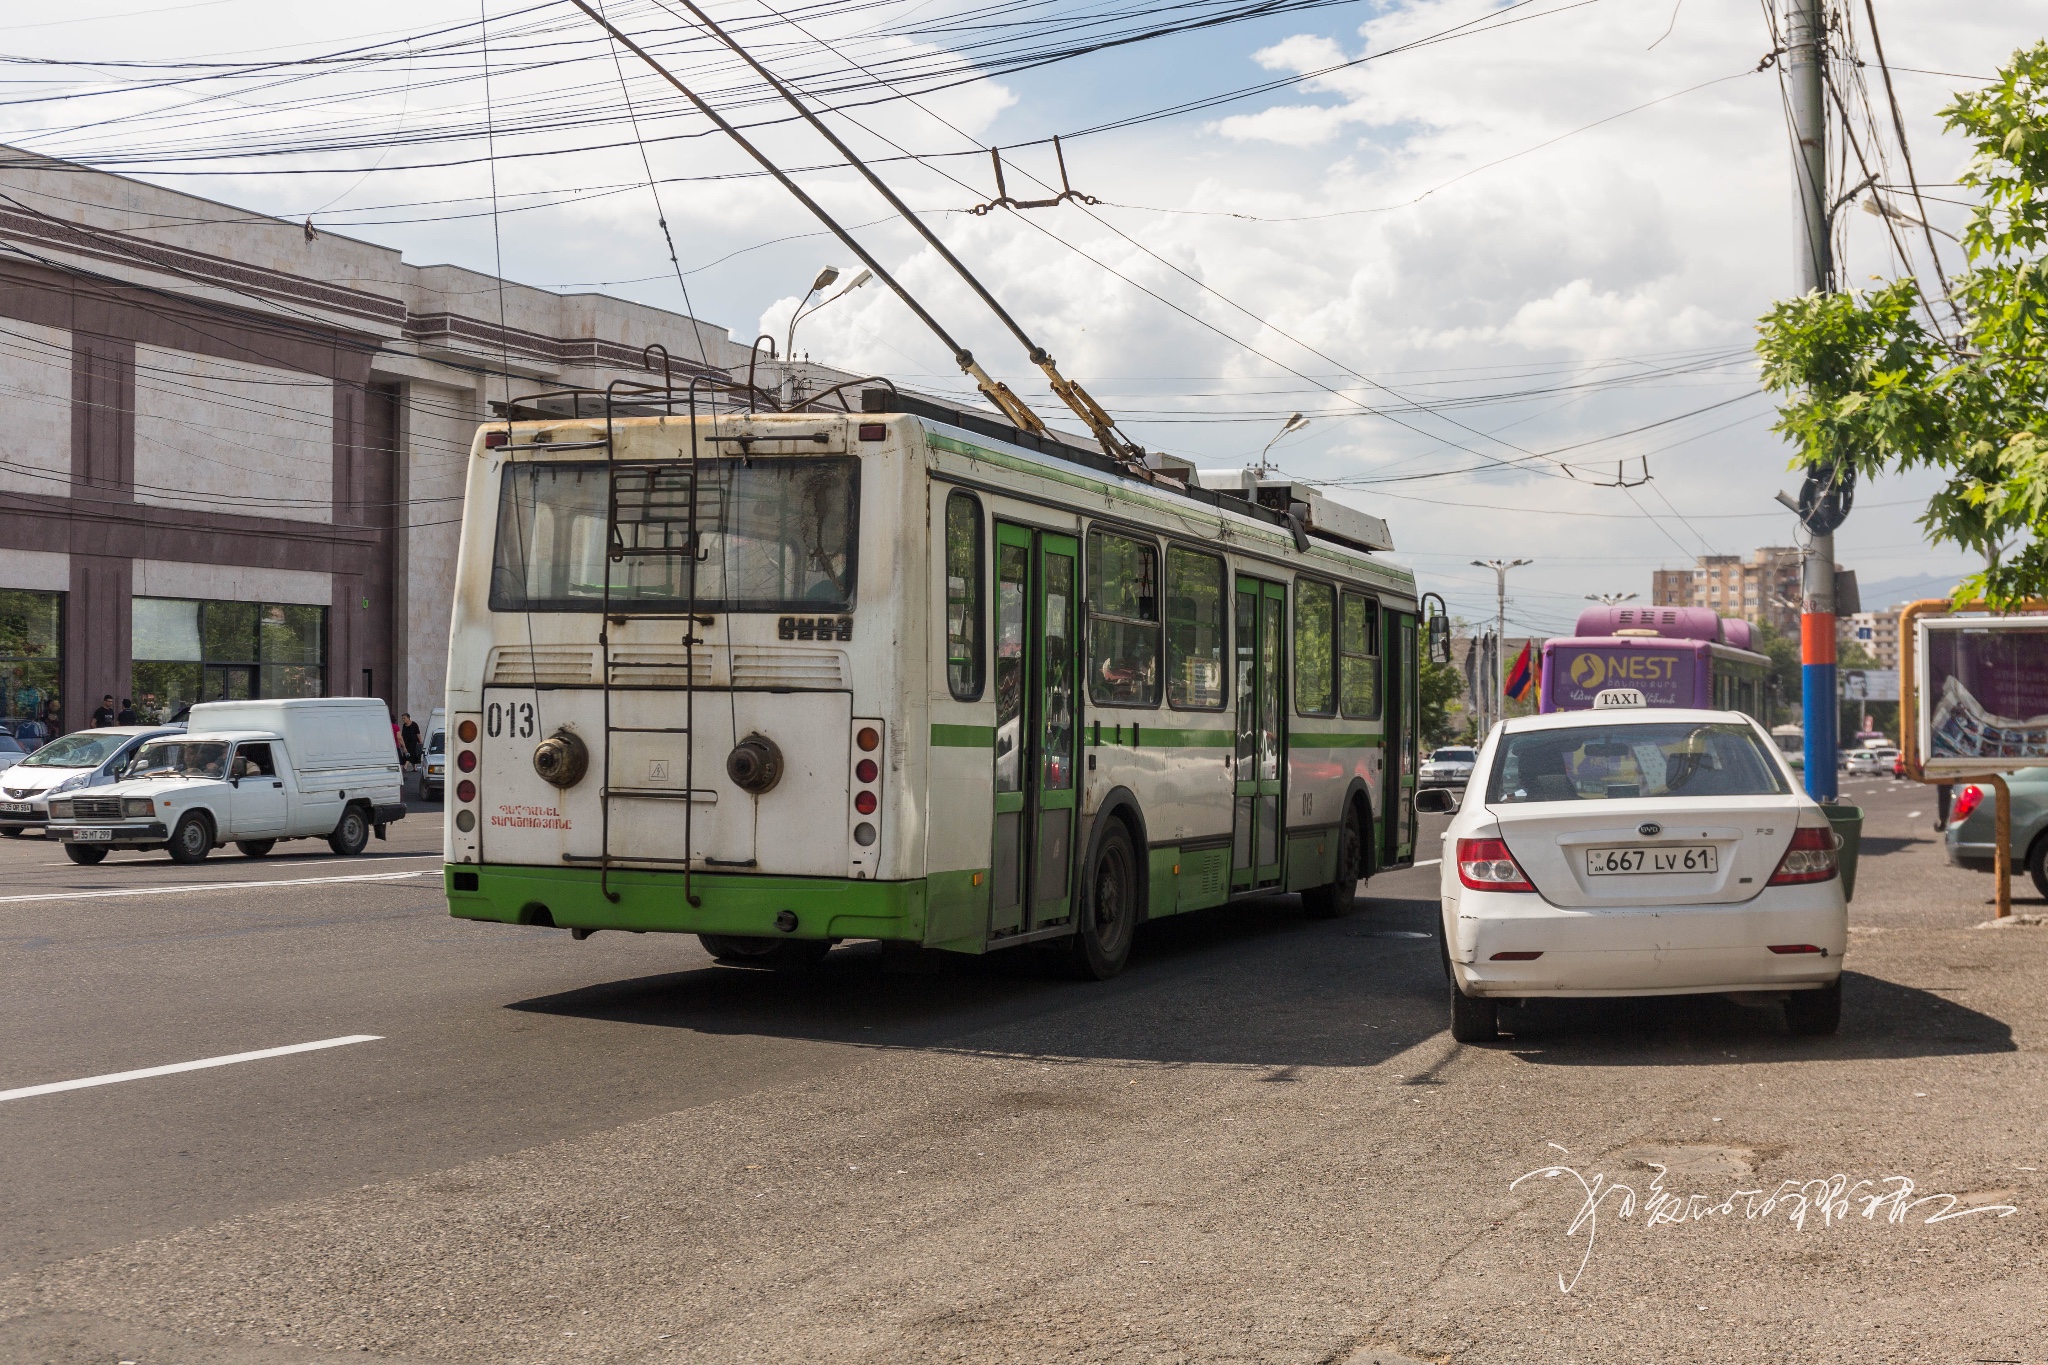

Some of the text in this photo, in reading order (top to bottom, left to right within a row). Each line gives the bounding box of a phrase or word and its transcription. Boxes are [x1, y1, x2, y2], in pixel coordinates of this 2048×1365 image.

[1608, 656, 1679, 679] NEST
[1601, 693, 1639, 705] TAXI
[487, 702, 534, 738] 013
[81, 830, 88, 839] 35
[100, 831, 110, 840] 299
[1606, 850, 1645, 871] 667
[1655, 855, 1676, 870] LV
[1683, 849, 1709, 869] 61
